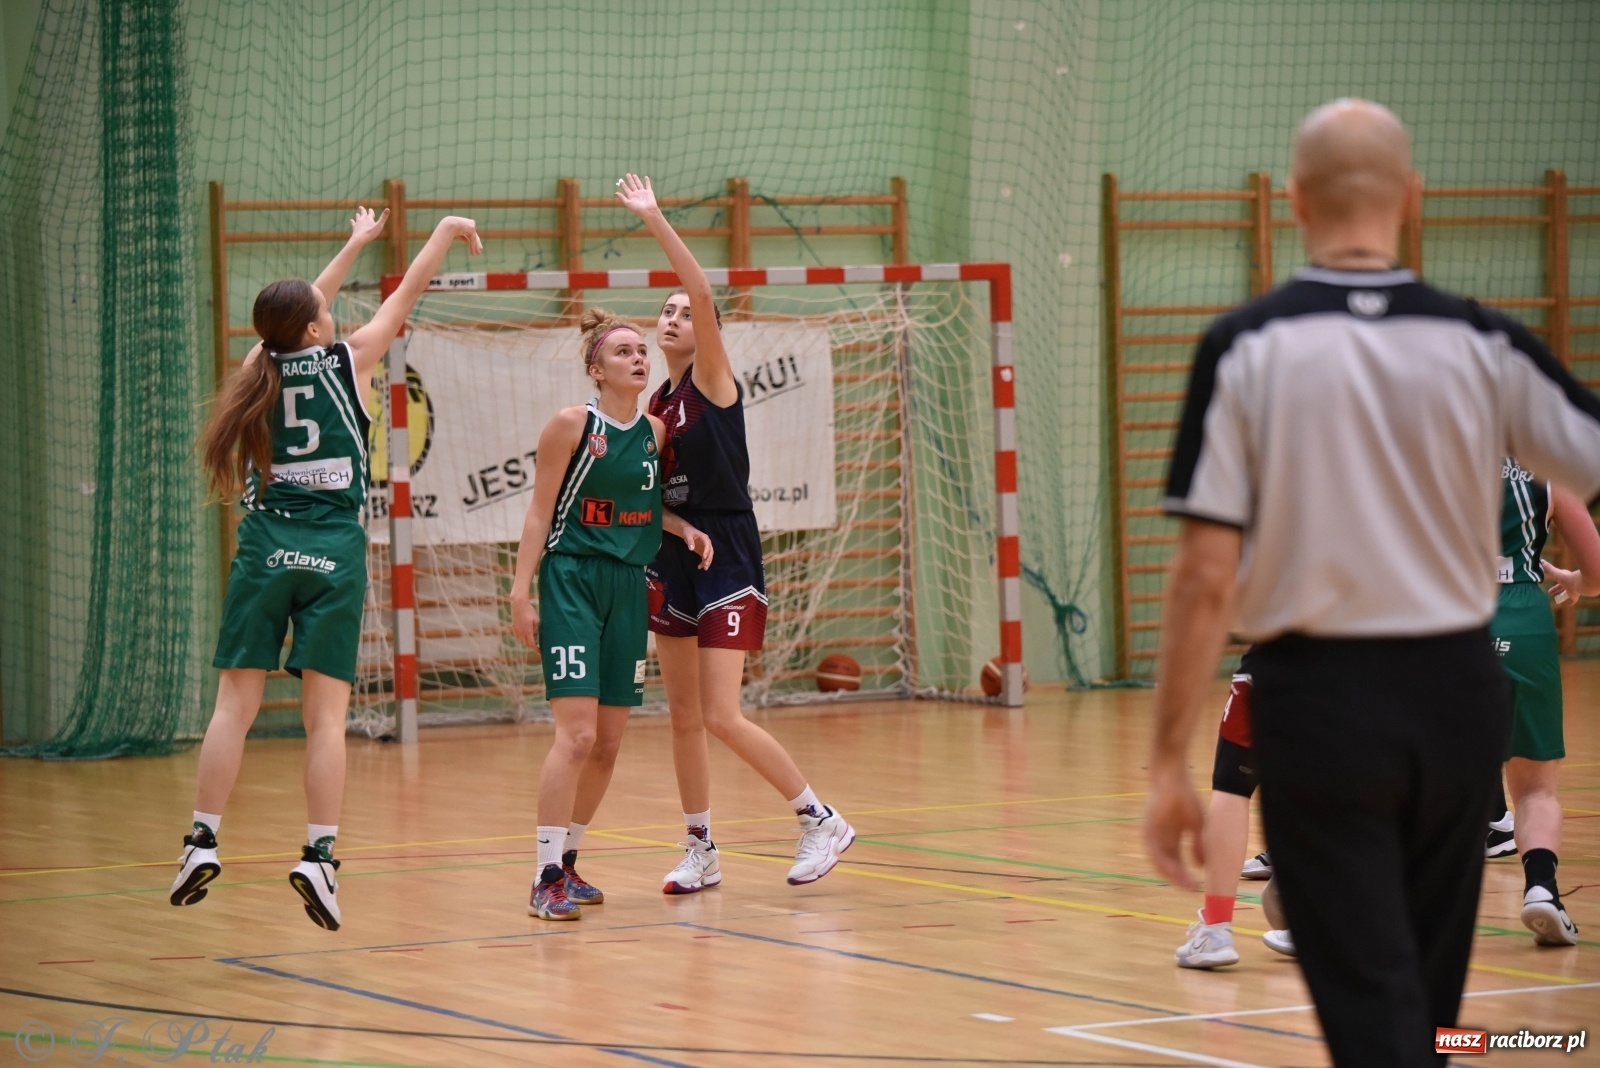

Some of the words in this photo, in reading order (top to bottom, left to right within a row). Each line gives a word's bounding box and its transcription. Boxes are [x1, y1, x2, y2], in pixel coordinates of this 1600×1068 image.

[283, 384, 320, 456] 5
[462, 450, 537, 505] JEST
[641, 460, 658, 490] 3
[583, 501, 609, 523] K
[283, 551, 337, 571] Clavis
[727, 611, 740, 637] 9
[550, 645, 586, 681] 35
